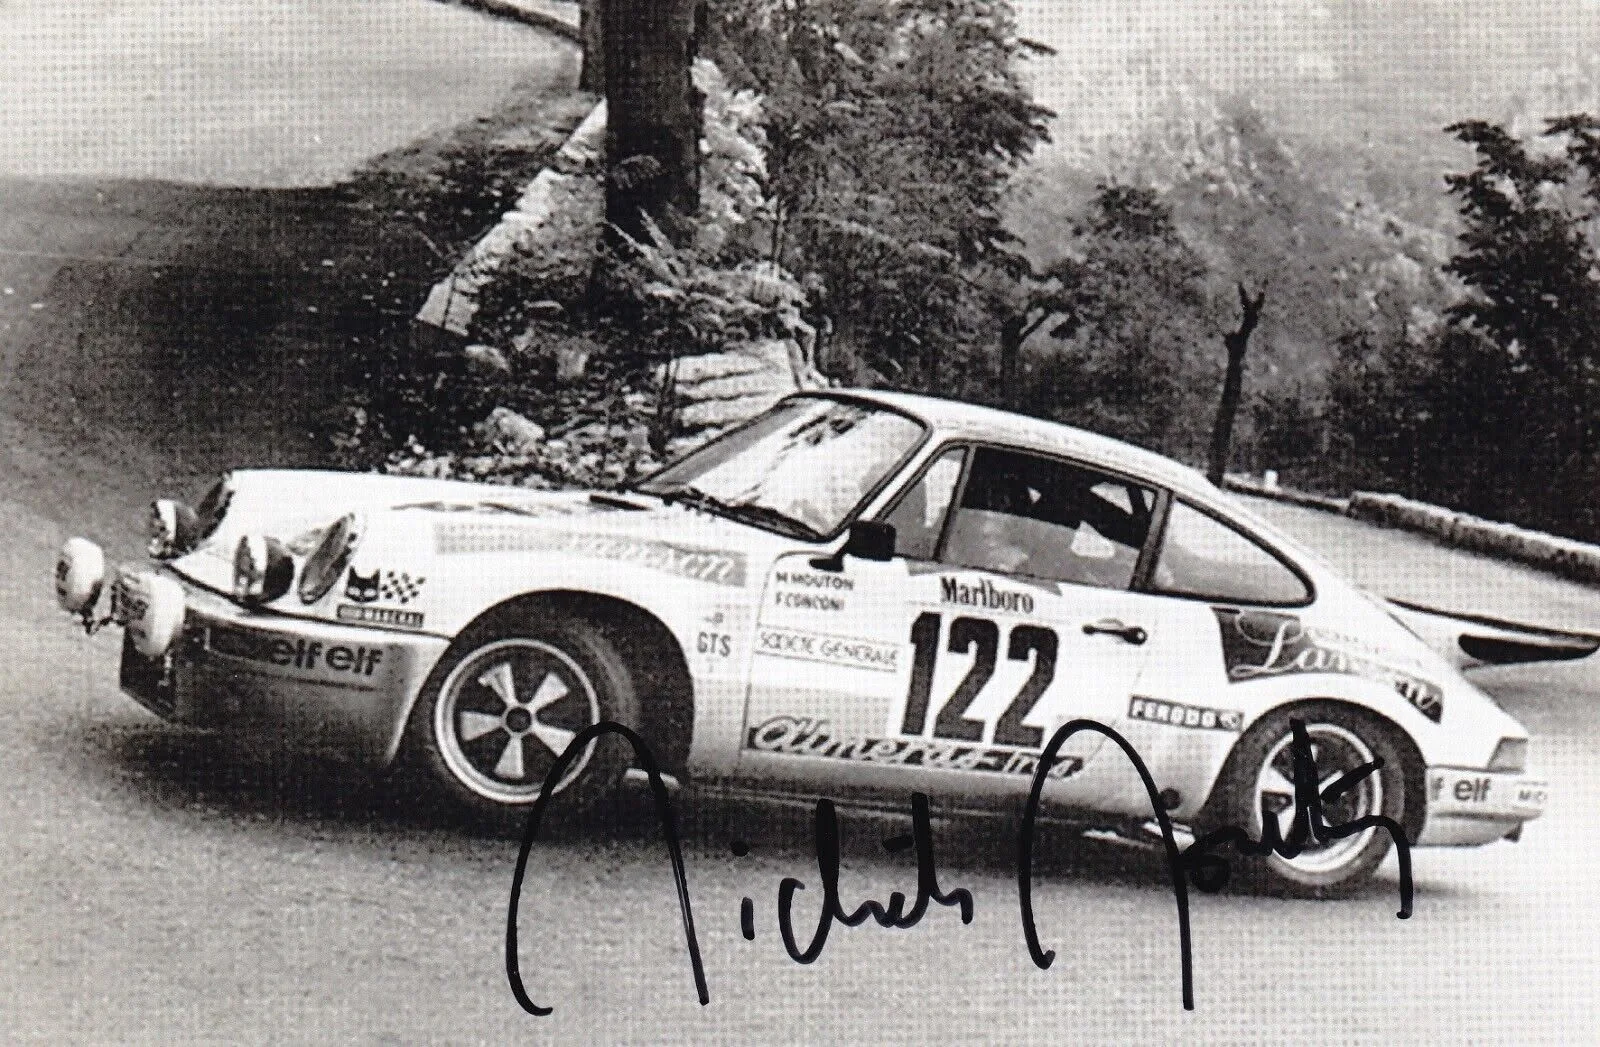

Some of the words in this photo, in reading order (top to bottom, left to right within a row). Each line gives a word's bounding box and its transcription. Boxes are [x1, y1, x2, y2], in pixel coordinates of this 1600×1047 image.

[940, 575, 1034, 614] Marlboro
[268, 638, 324, 670] elf
[325, 645, 384, 676] elf
[697, 631, 732, 659] GTS
[901, 610, 1060, 748] 122
[1453, 777, 1491, 803] elf
